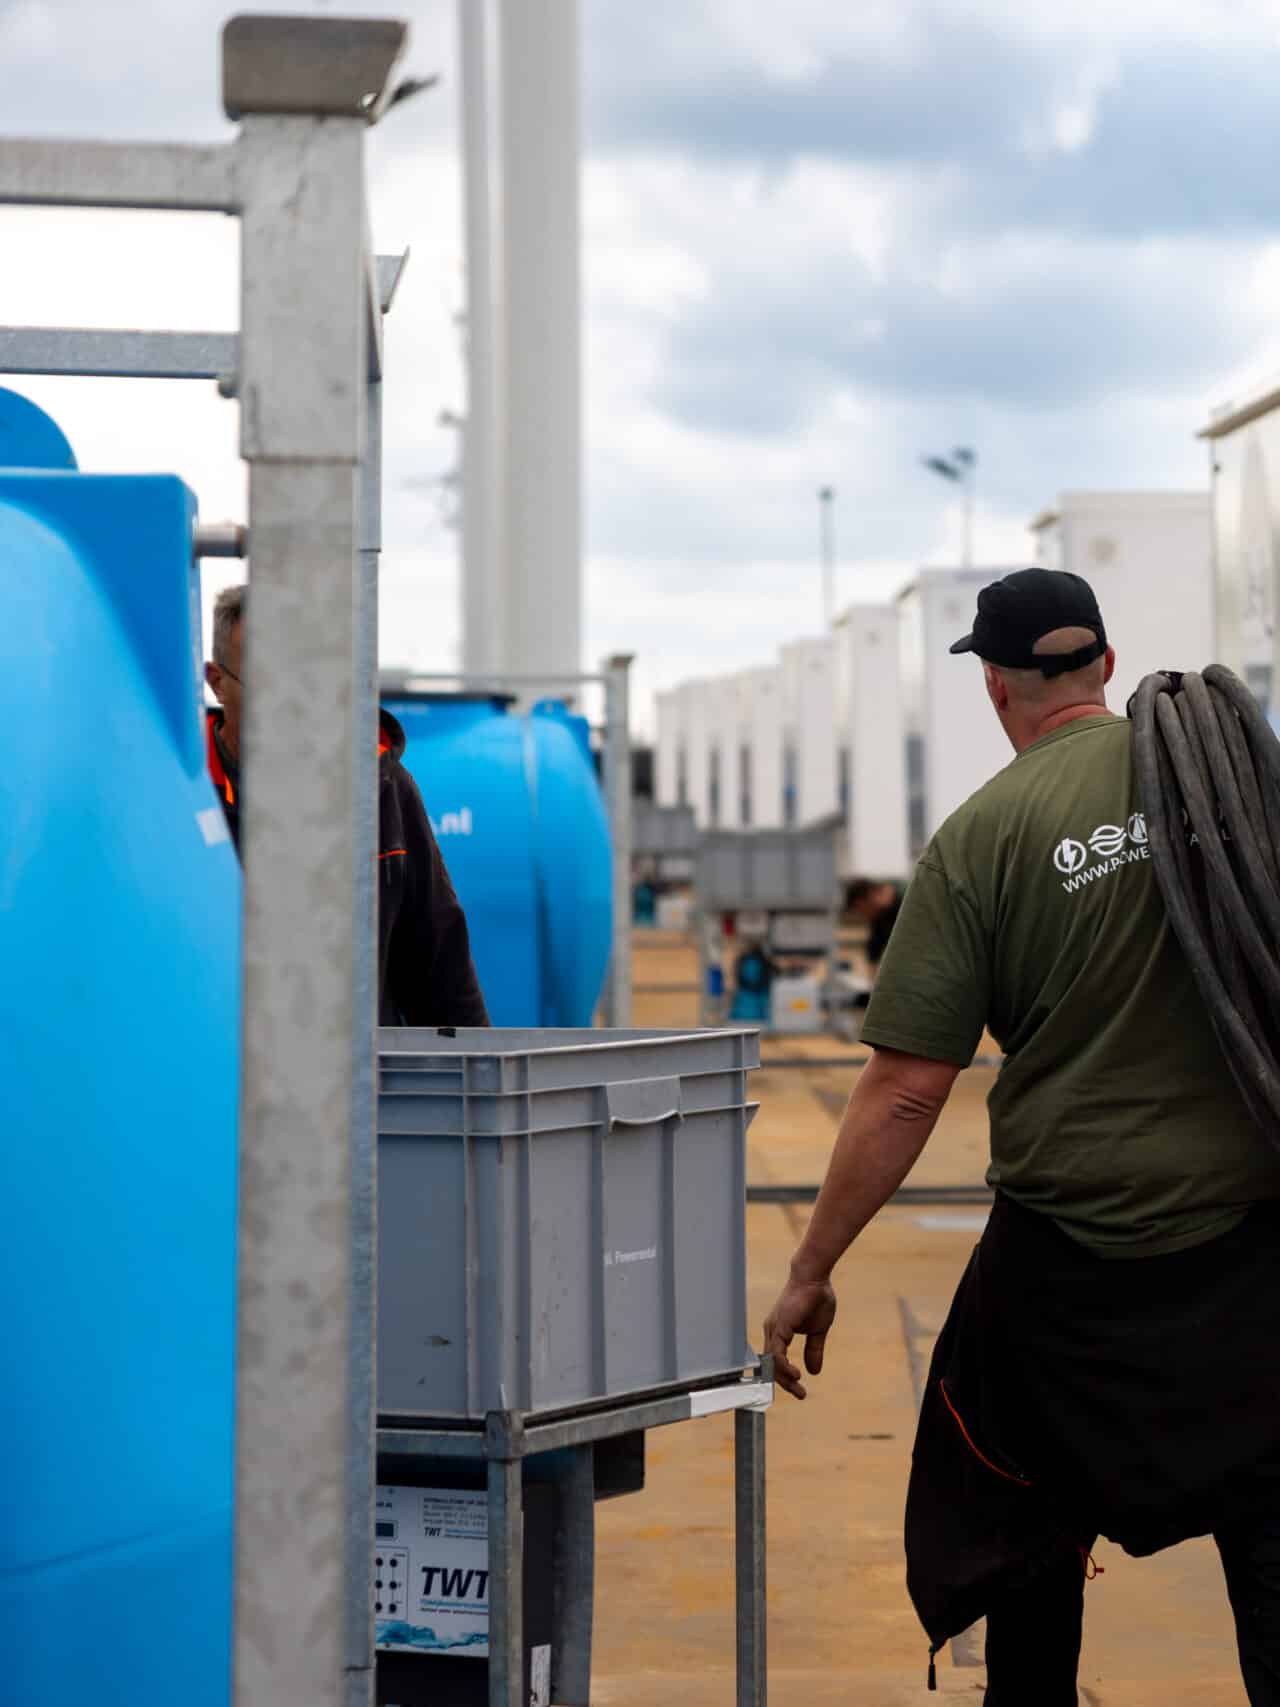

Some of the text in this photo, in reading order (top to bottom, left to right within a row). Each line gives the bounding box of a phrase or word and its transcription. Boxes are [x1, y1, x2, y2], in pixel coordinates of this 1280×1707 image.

[1062, 846, 1150, 893] WWW.POWE
[424, 1527, 441, 1537] TWT
[421, 1565, 489, 1599] TWT
